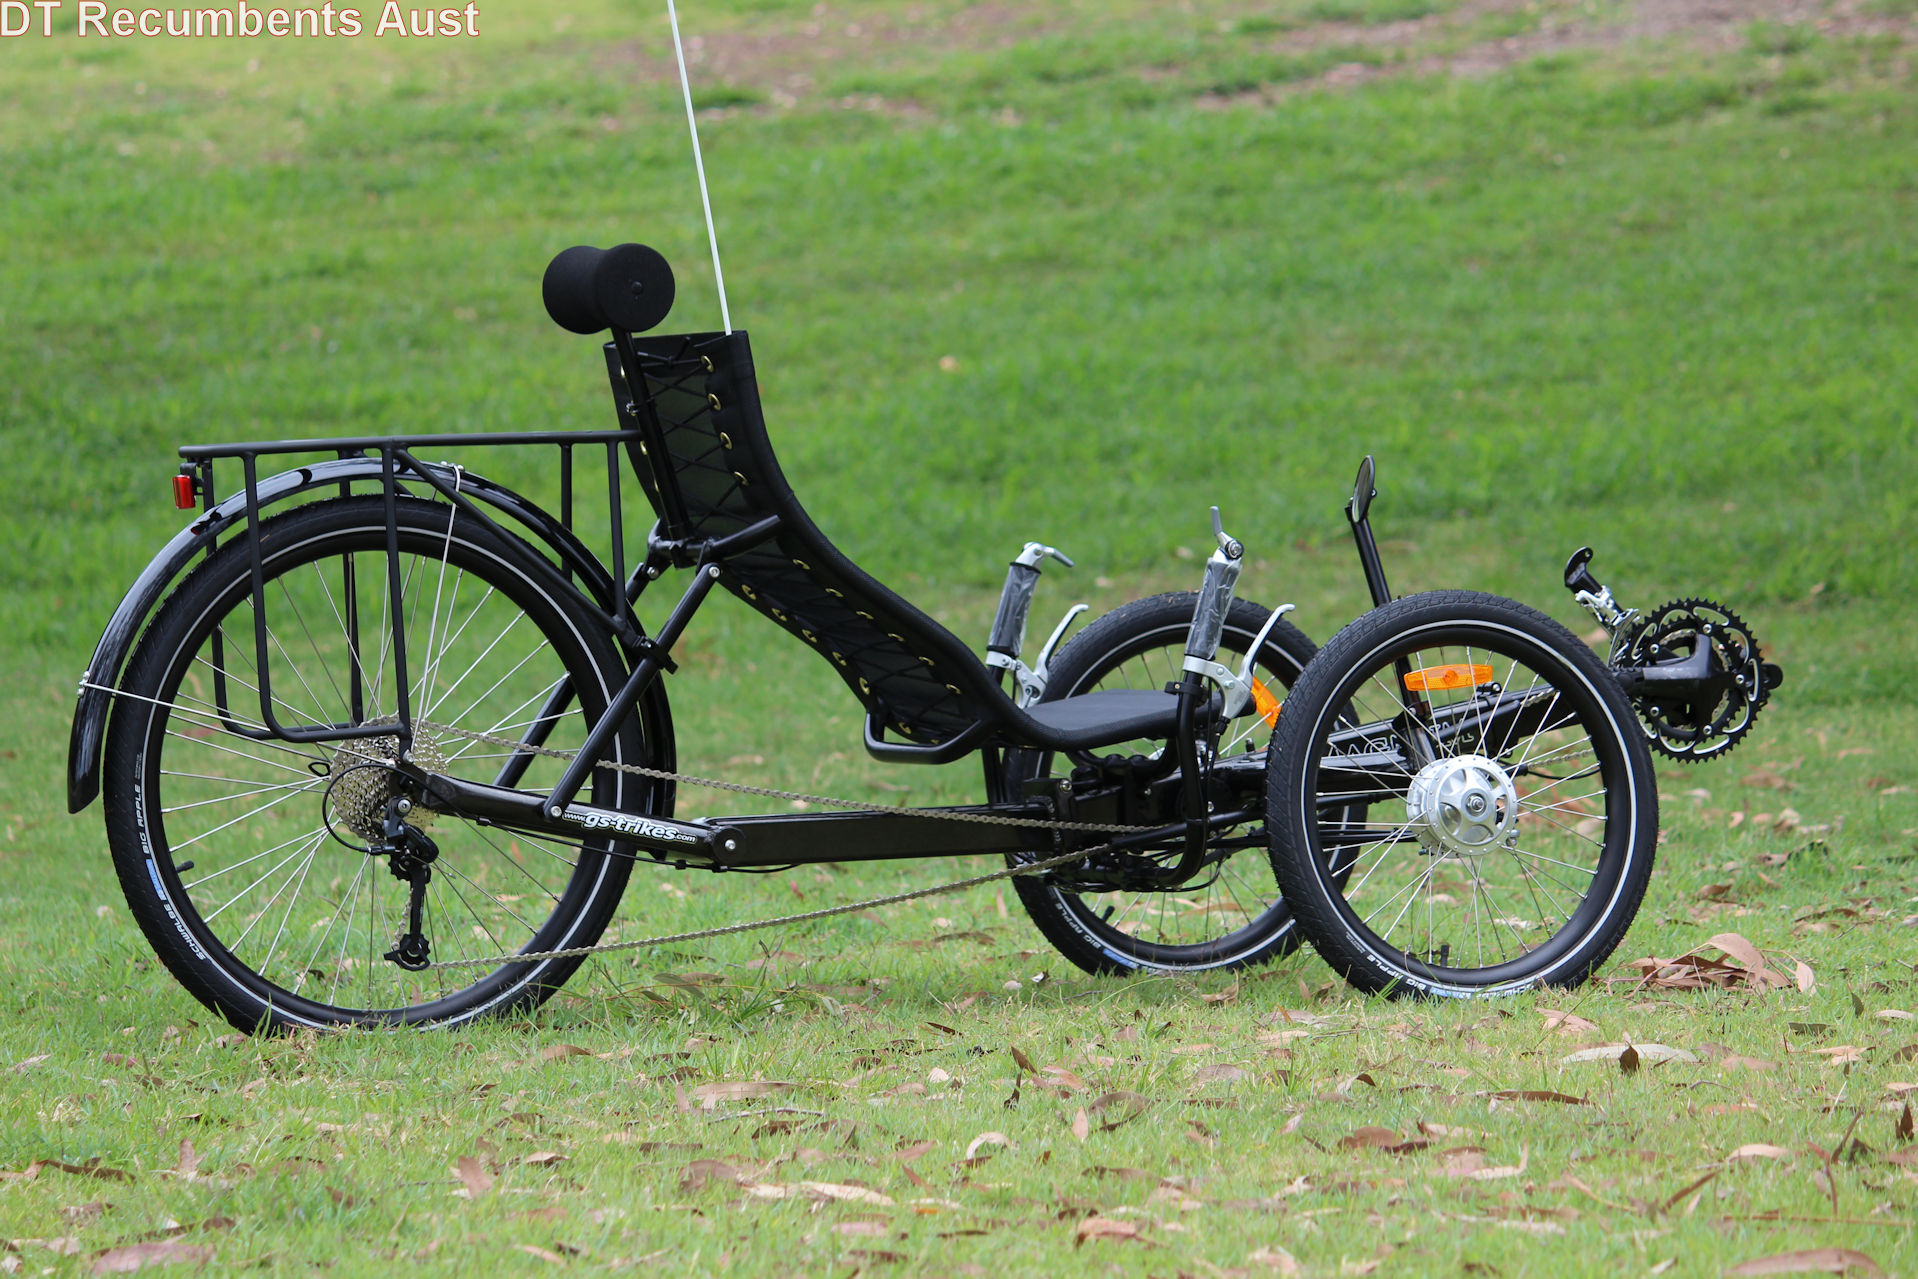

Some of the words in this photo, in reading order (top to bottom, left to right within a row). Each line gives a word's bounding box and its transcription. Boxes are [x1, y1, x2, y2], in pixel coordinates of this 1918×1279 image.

[134, 784, 145, 827] APPLE
[140, 831, 150, 854] BIG
[163, 903, 206, 960] SCHWALBE
[1366, 954, 1404, 980] APPLE
[1405, 978, 1427, 990] BIG
